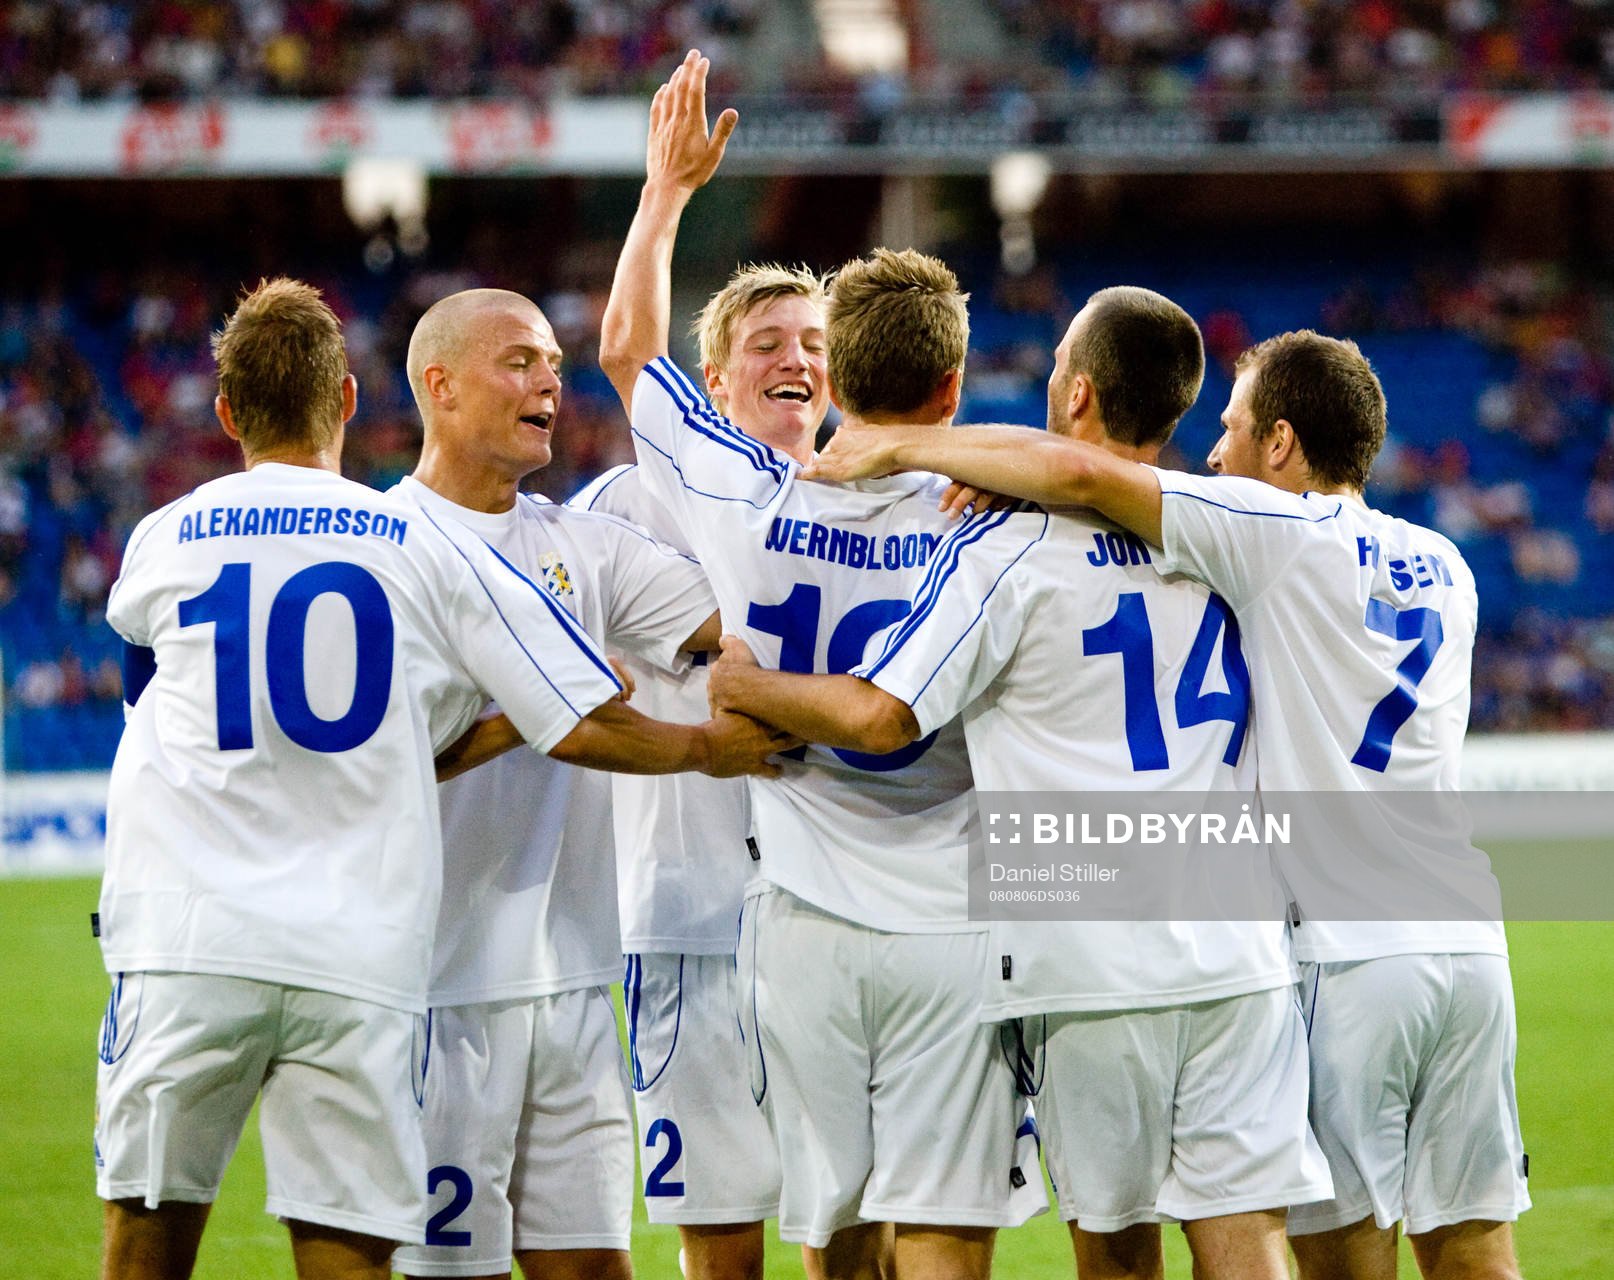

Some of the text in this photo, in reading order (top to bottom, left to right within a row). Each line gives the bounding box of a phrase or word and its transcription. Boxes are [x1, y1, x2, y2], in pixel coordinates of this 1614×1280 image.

[178, 507, 408, 546] ALEXANDERSSON
[1356, 535, 1454, 592] HSEN
[178, 561, 394, 753] 10
[1082, 592, 1251, 771] 14
[1350, 597, 1445, 773] 7
[645, 1118, 685, 1197] 2
[425, 1165, 473, 1246] 2
